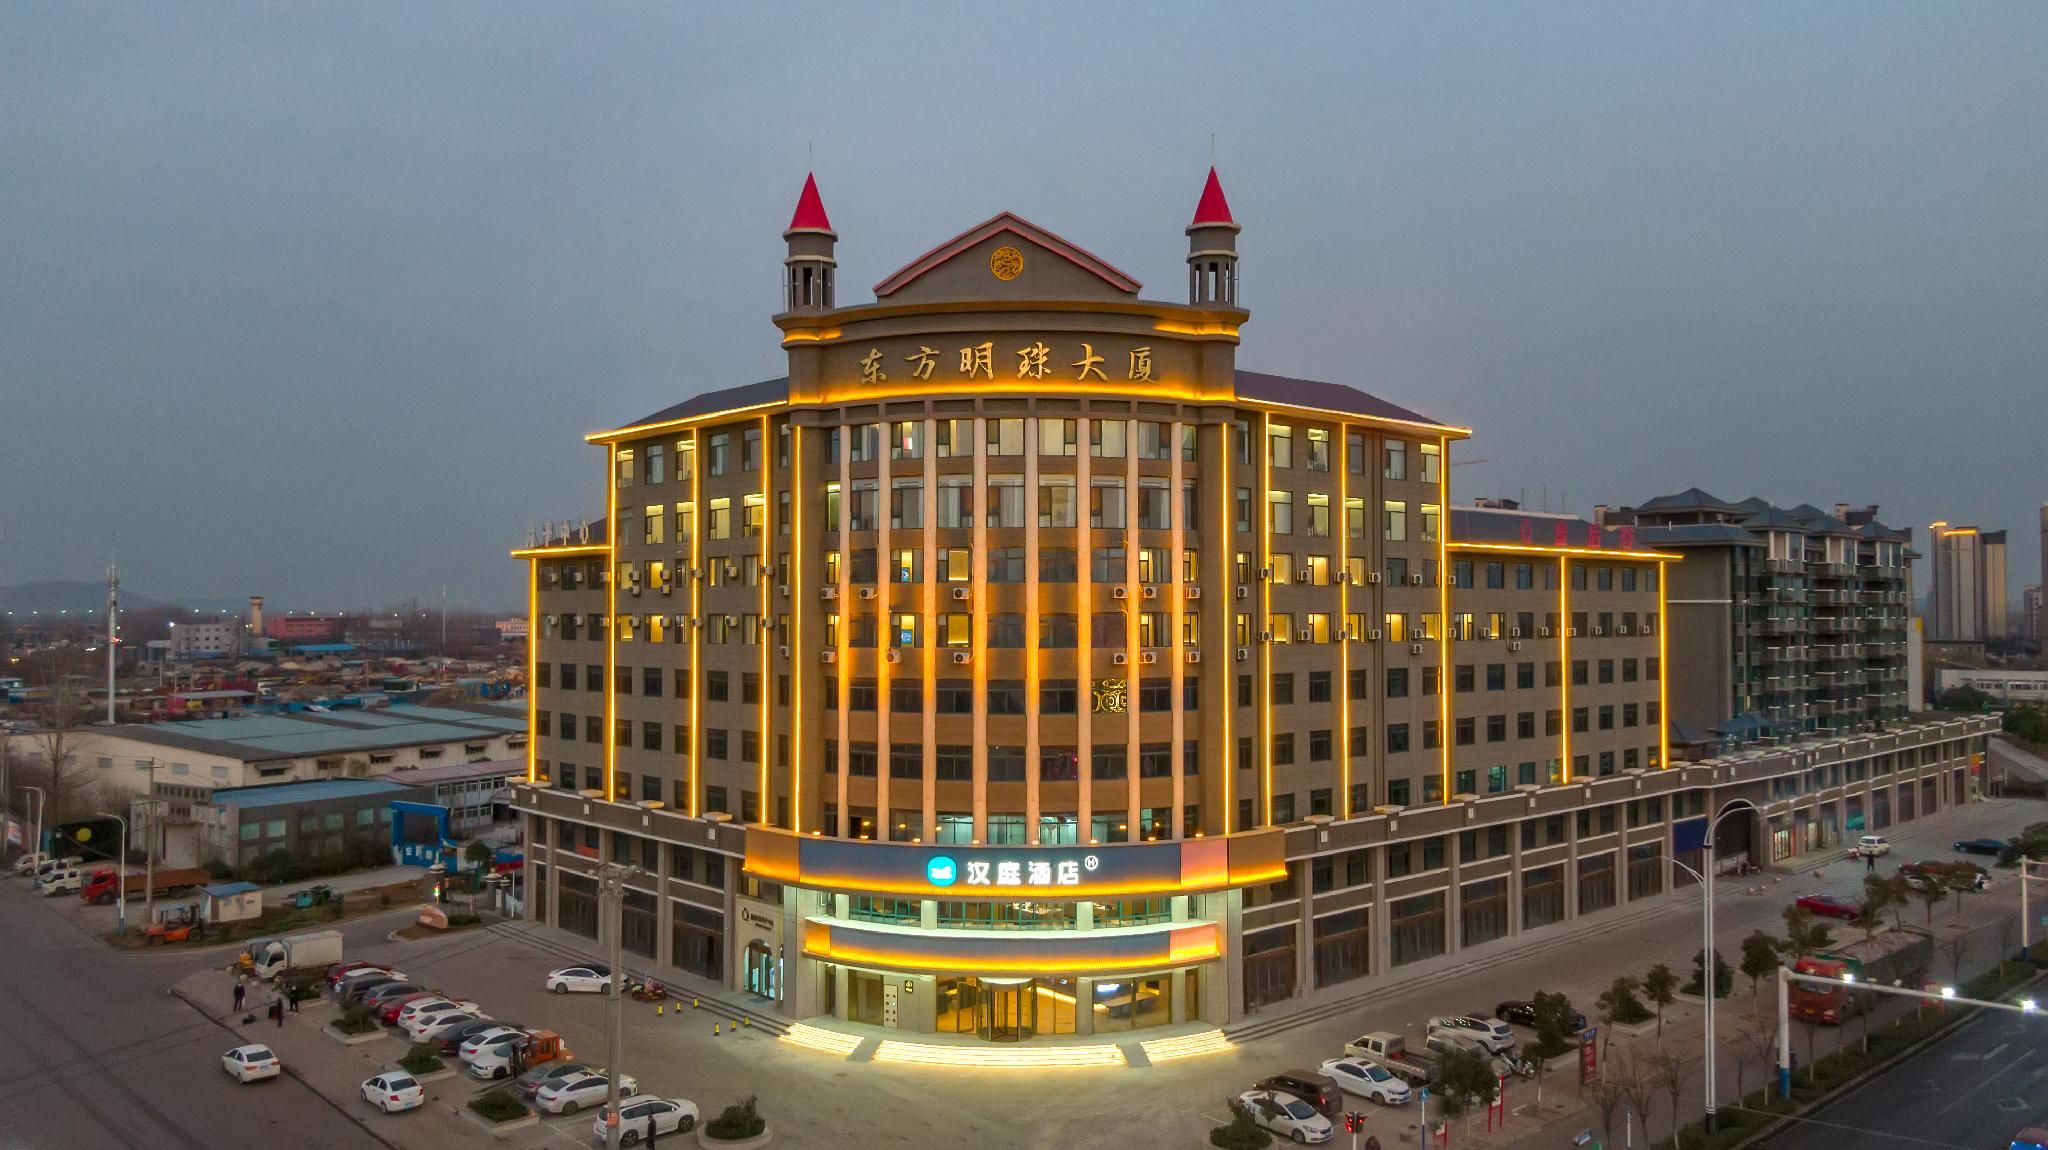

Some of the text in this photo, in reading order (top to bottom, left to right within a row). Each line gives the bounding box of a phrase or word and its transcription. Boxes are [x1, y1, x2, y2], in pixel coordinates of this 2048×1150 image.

[859, 341, 1159, 385] 东方明珠大厦
[967, 860, 1080, 885] 汉庭酒店
